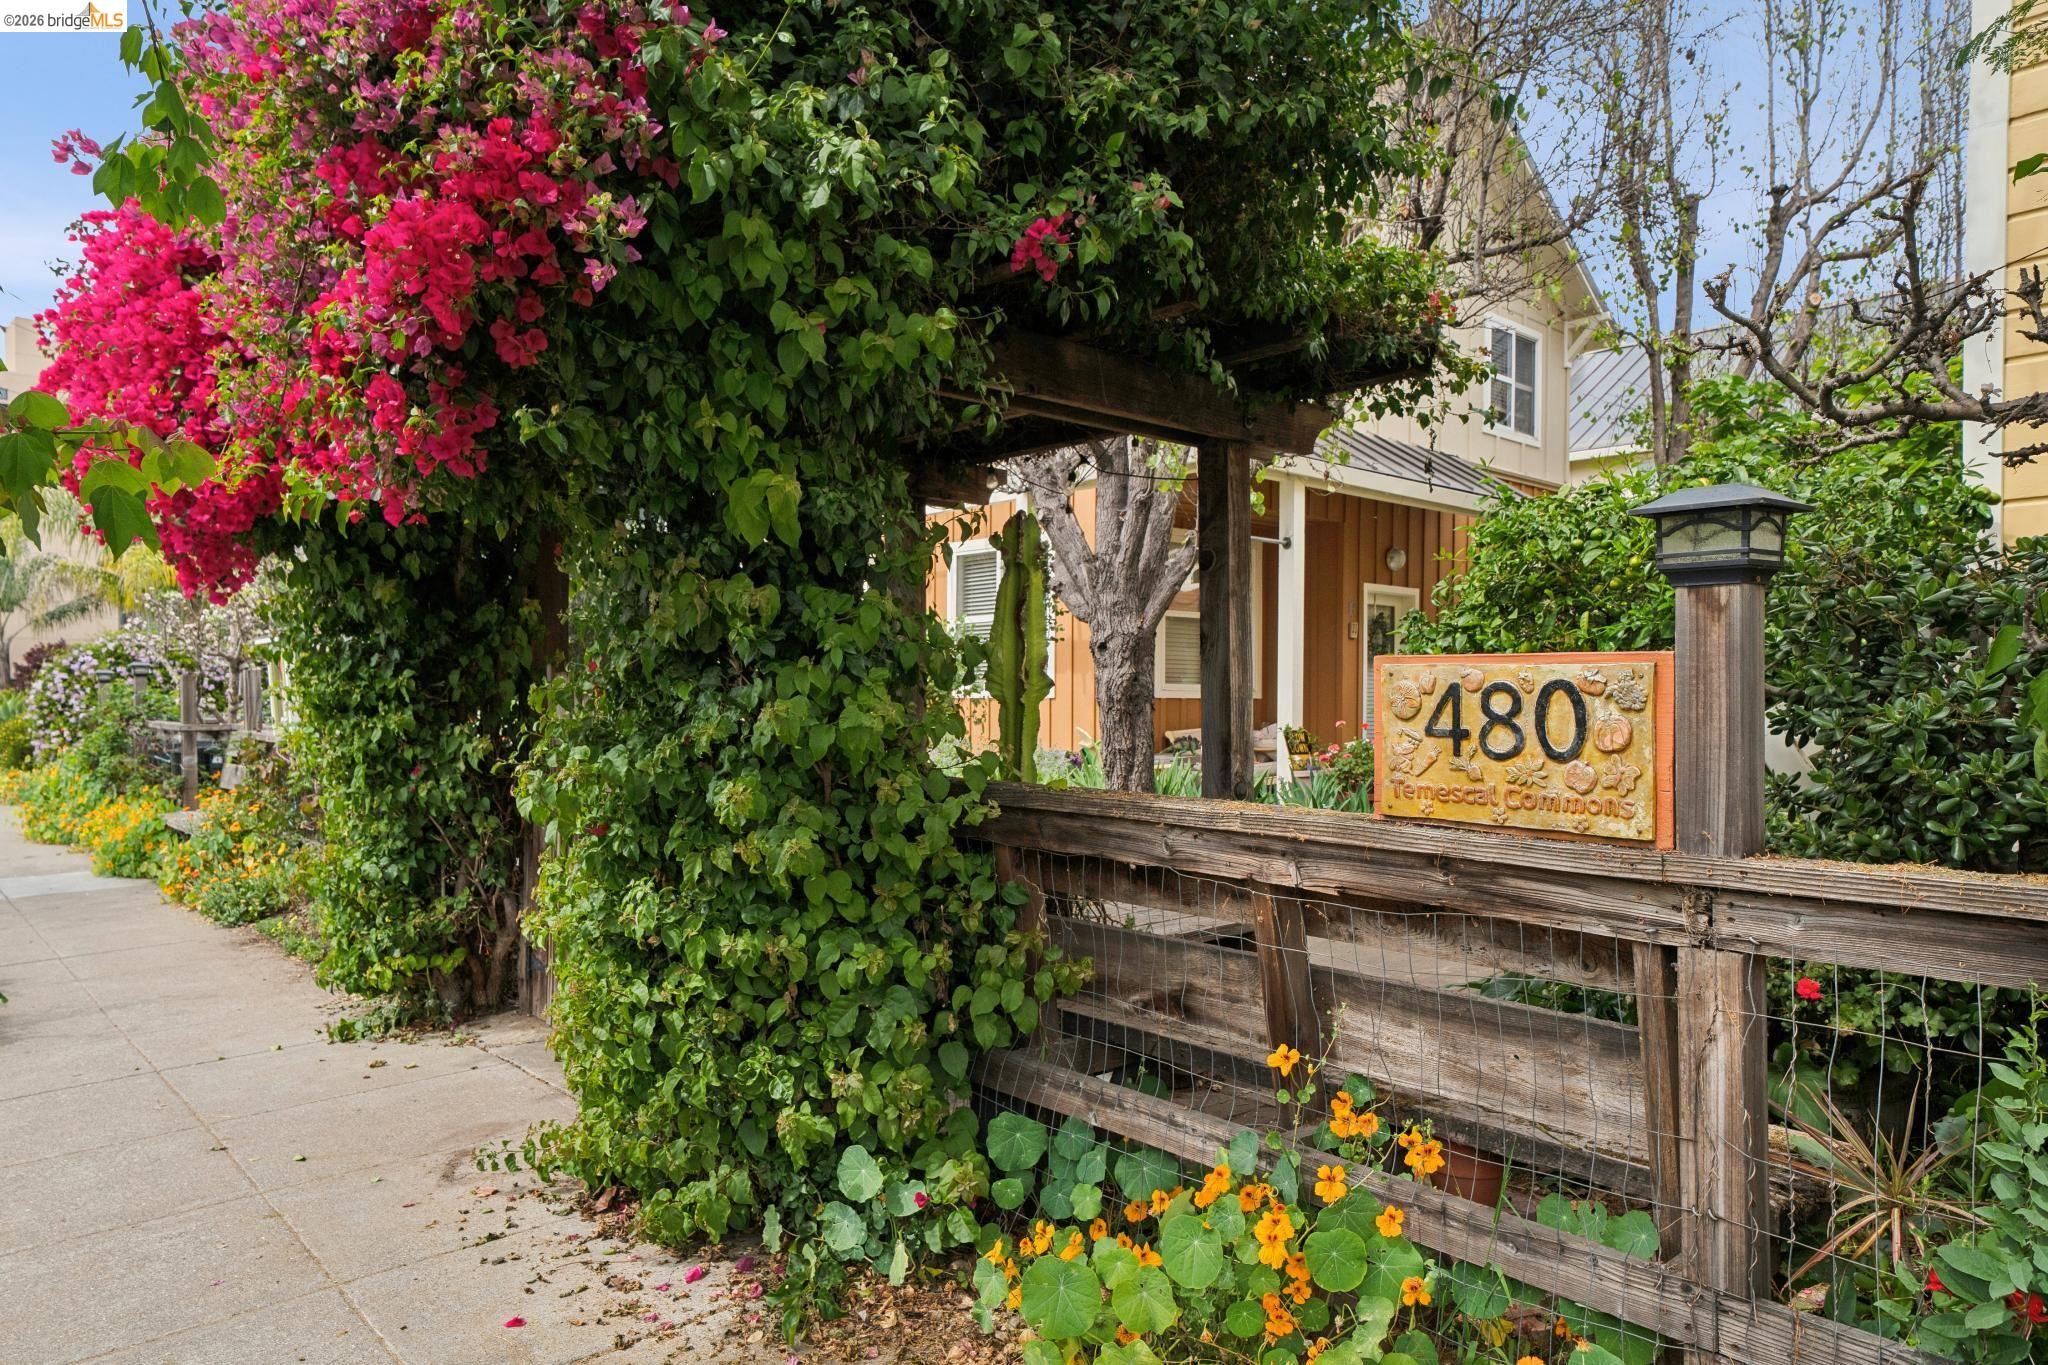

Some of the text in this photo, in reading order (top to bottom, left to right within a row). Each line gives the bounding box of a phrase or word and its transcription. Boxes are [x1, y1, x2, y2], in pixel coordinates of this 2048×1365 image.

[1424, 679, 1587, 762] 480
[1391, 780, 1635, 819] Temescal Commons
